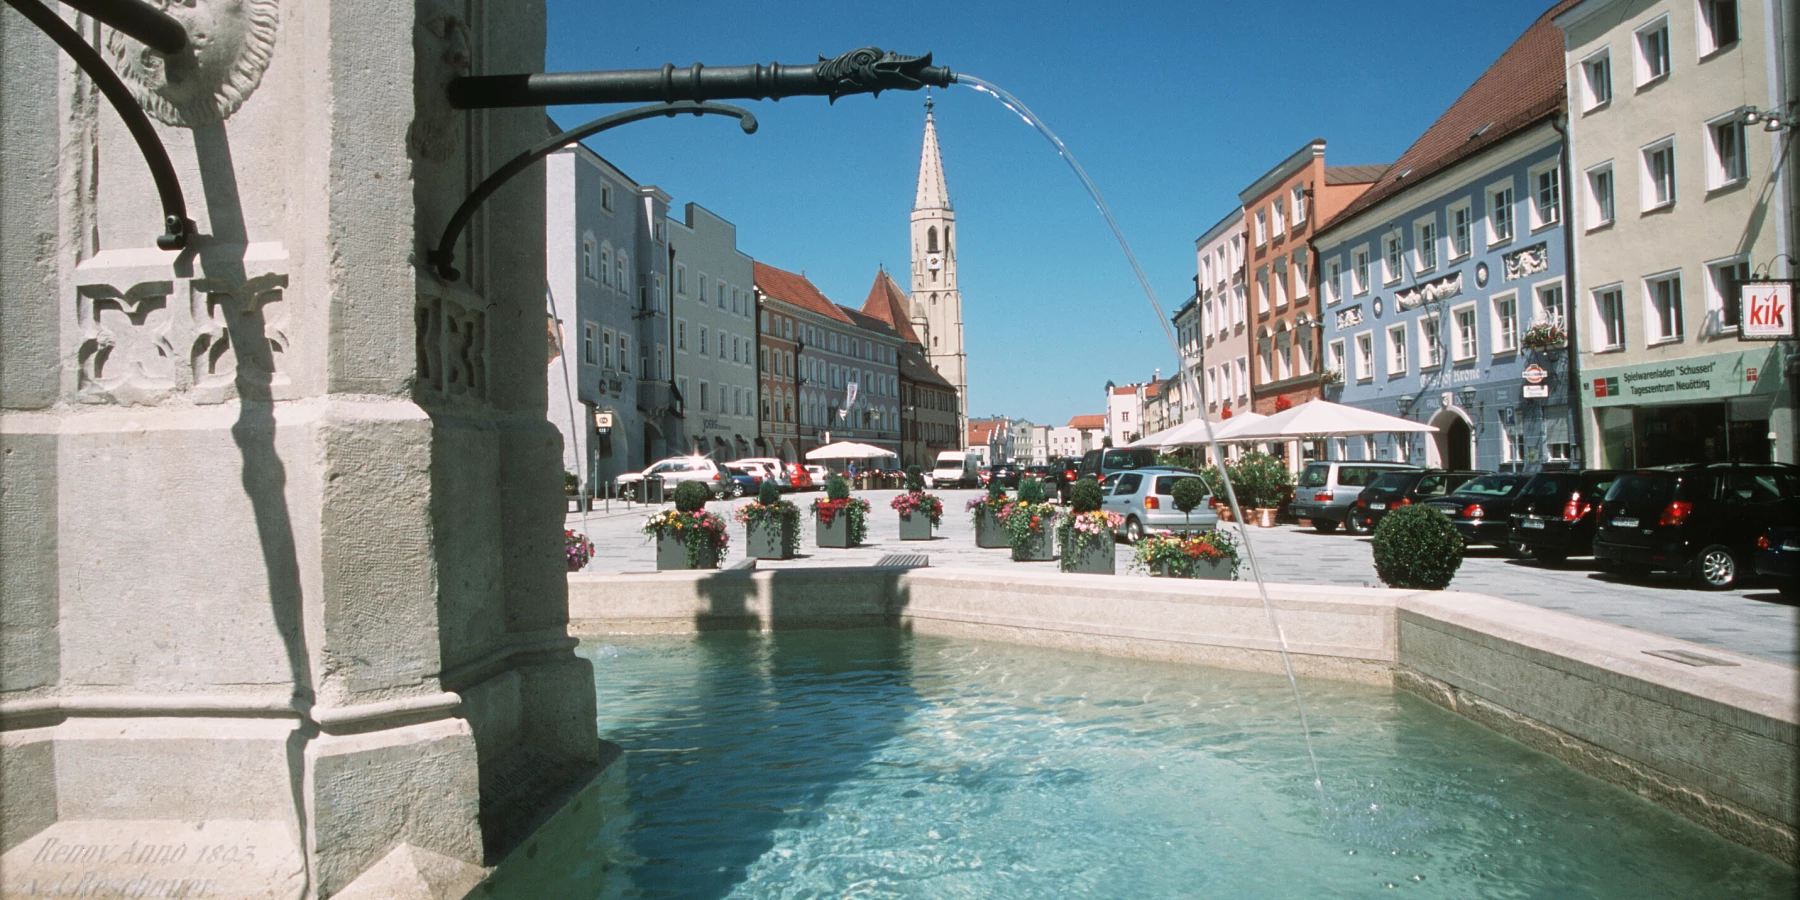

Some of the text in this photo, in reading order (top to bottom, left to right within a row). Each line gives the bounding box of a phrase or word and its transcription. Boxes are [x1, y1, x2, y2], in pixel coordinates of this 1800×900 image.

[1749, 290, 1786, 325] kik
[1623, 368, 1675, 384] Spielwarenladen
[1630, 382, 1675, 396] Tageszentrum
[1675, 378, 1711, 391] Neuötting
[1507, 408, 1513, 422] P
[110, 838, 188, 865] Anno
